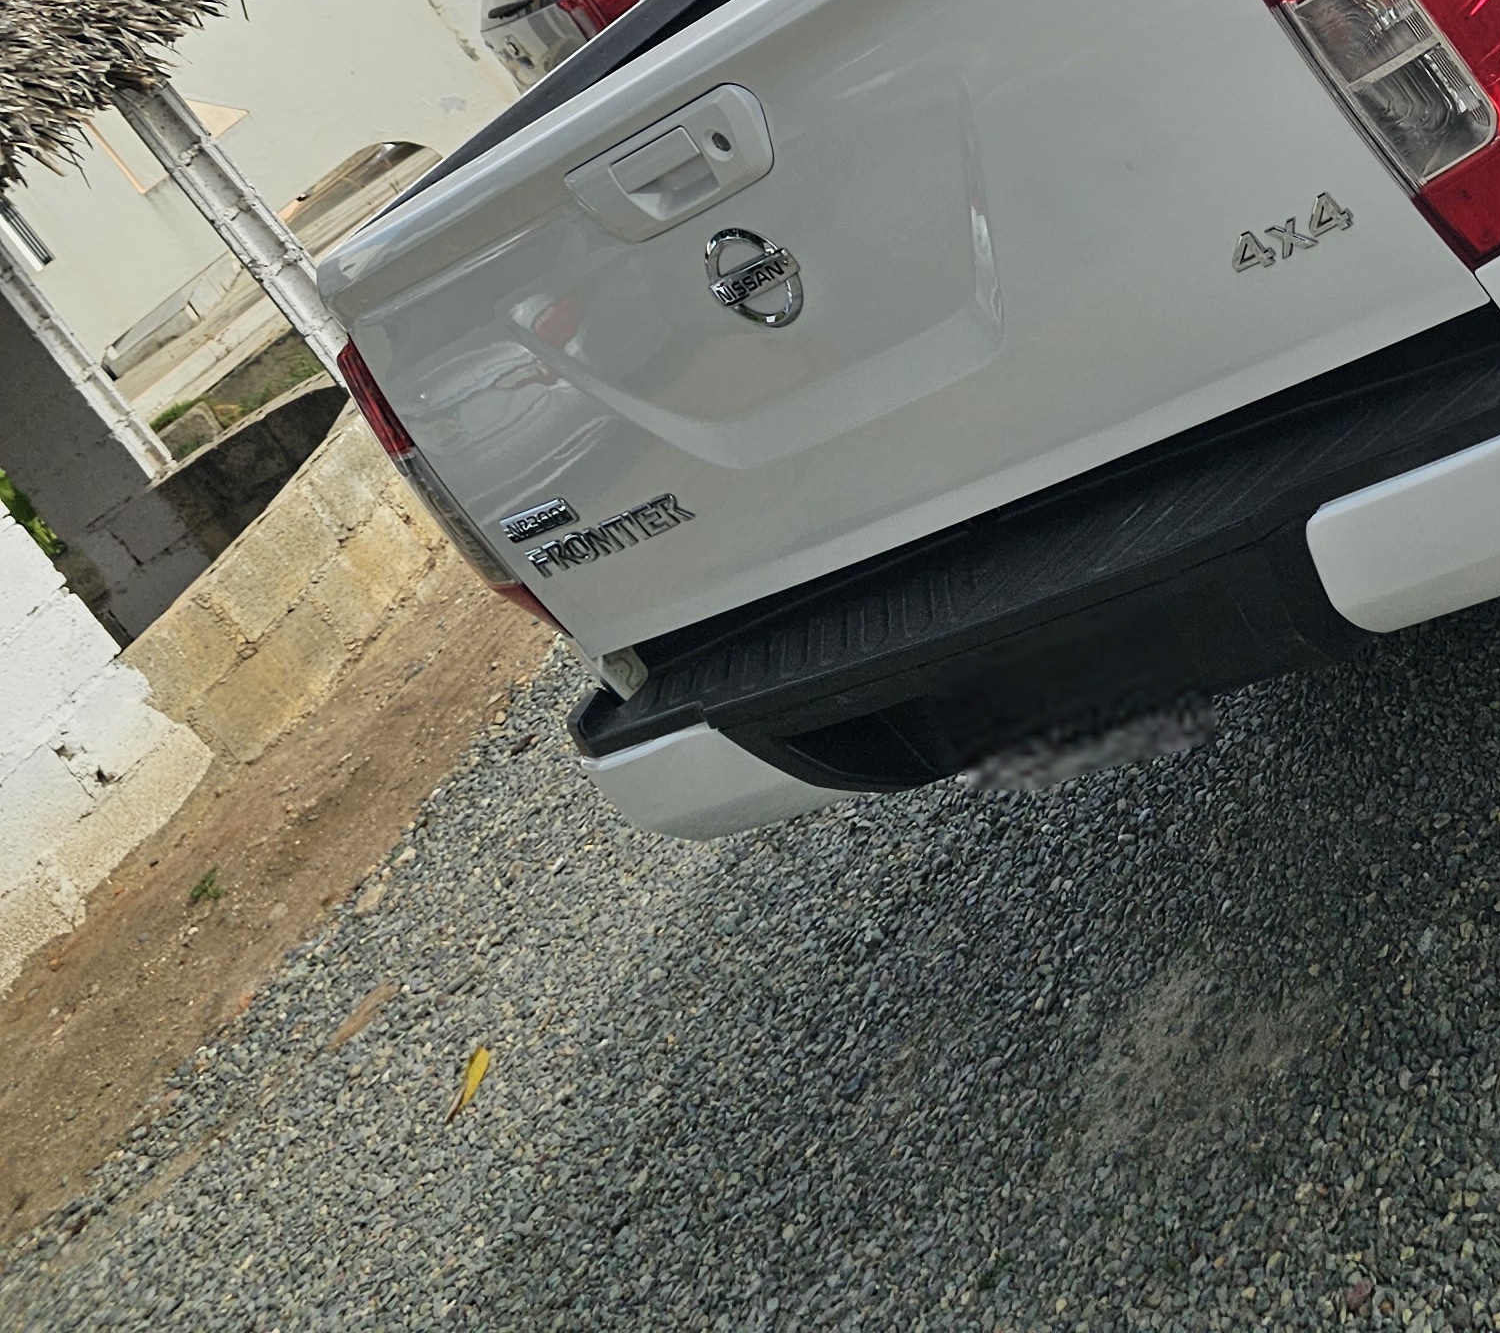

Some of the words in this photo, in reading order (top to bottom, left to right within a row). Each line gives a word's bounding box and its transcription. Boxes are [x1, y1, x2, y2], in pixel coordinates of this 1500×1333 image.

[715, 259, 786, 306] NISSAN
[505, 504, 569, 541] NP300
[526, 492, 697, 579] FRONTIER
